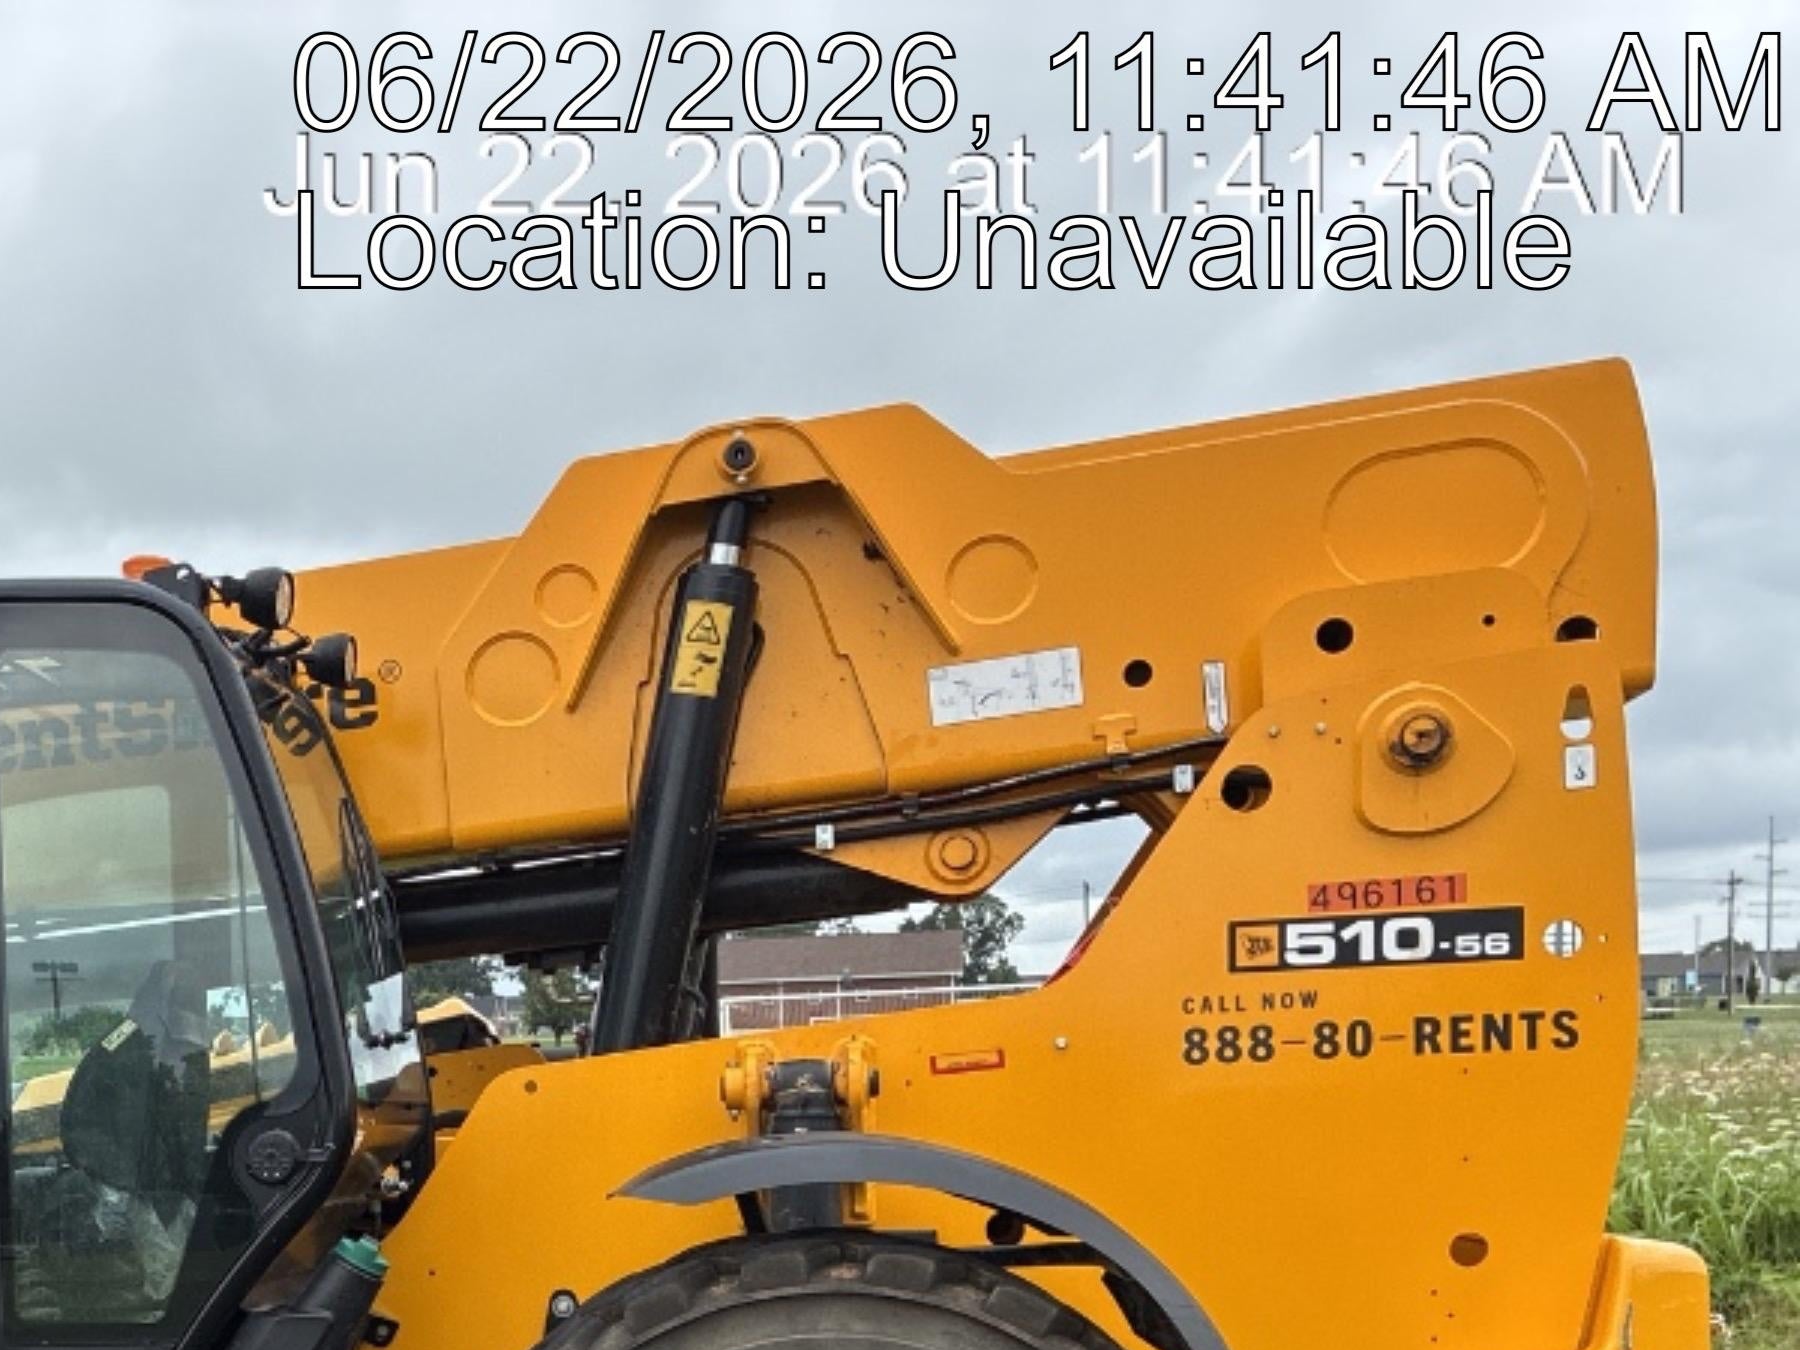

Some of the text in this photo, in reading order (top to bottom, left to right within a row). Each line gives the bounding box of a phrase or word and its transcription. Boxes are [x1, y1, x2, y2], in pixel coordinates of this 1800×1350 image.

[1310, 875, 1462, 911] 496161
[1282, 917, 1511, 966] 510-56
[1182, 990, 1319, 1015] CALL NOW
[1183, 1010, 1580, 1066] 888-80-RENTS
